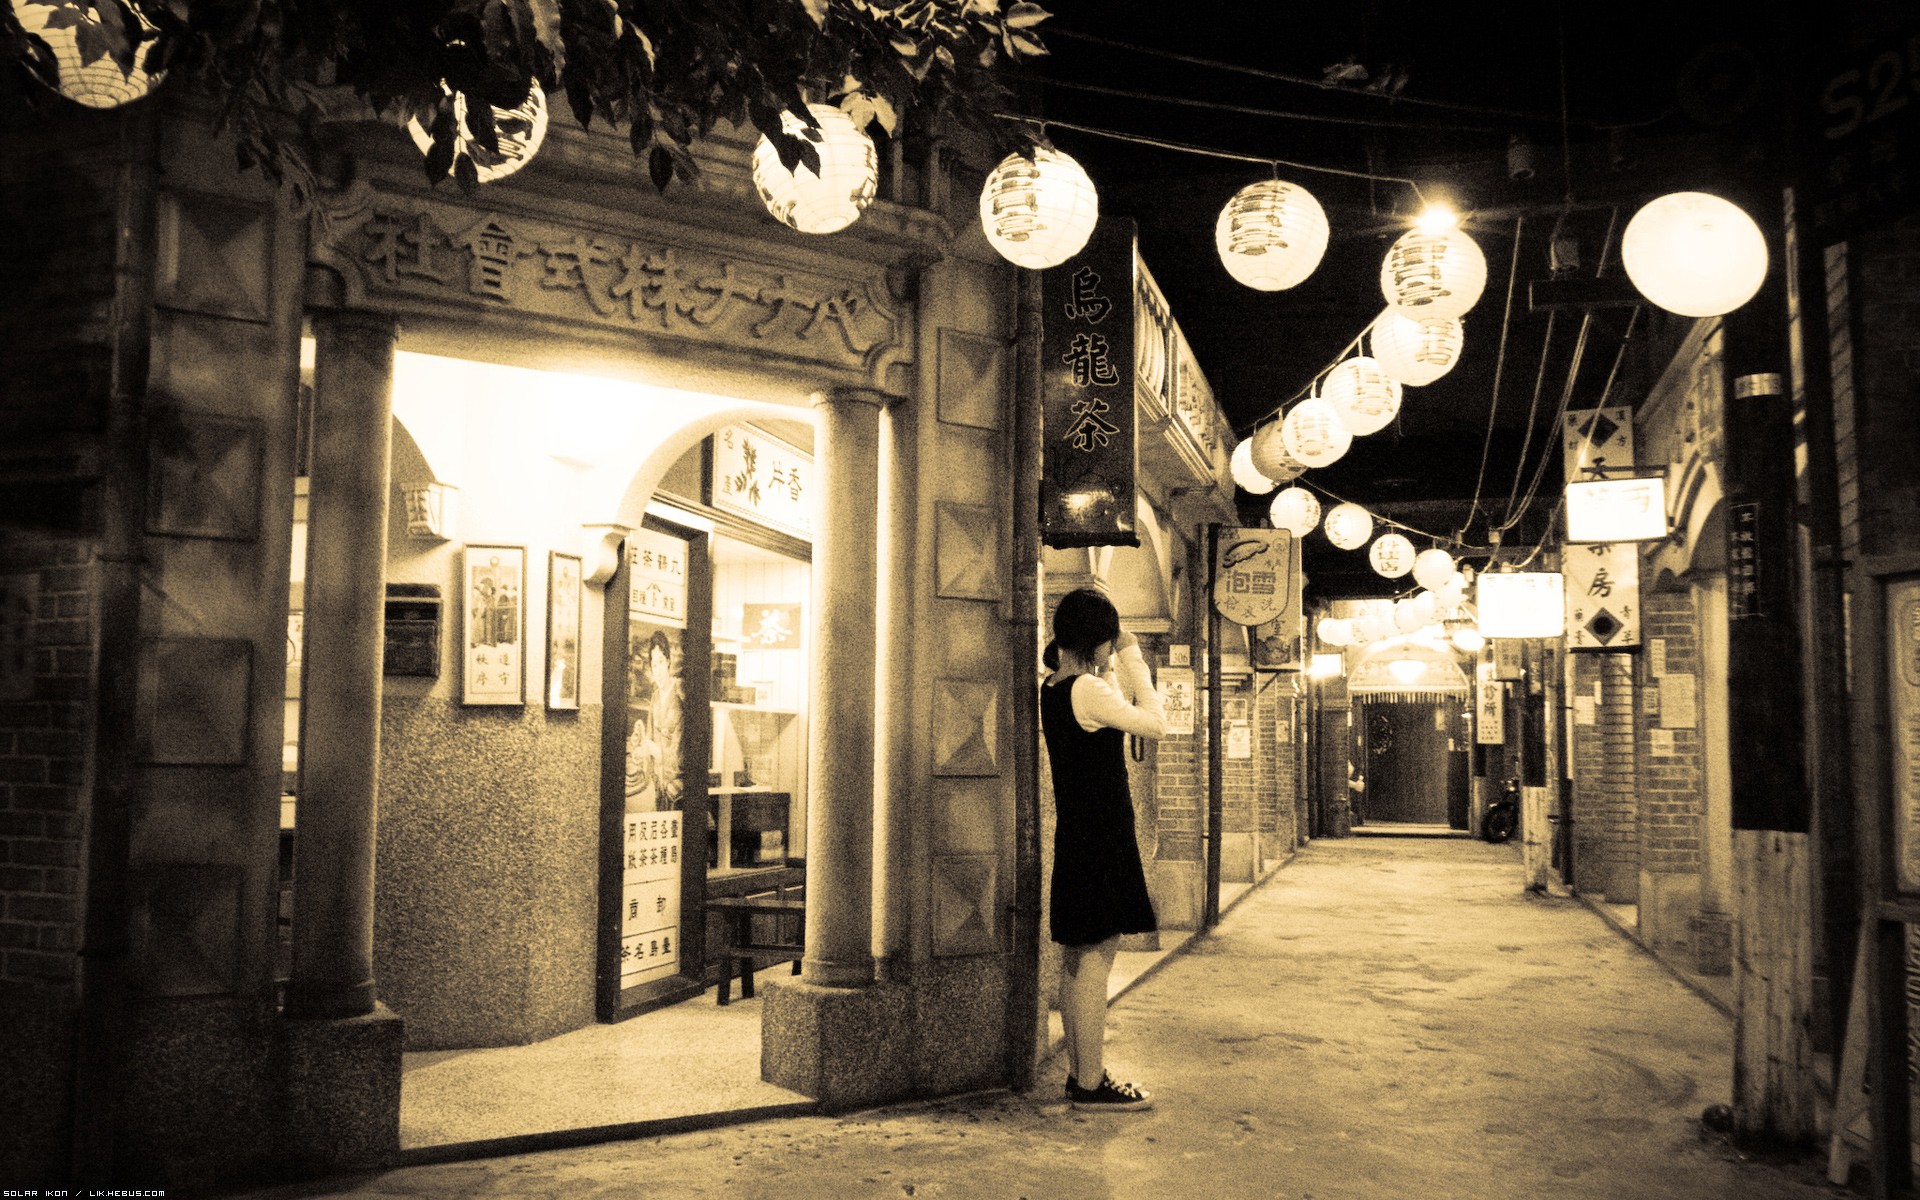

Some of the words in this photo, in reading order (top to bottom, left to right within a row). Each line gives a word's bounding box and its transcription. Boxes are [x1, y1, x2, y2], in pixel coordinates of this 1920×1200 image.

[1063, 266, 1119, 452] 烏龍茶
[751, 609, 793, 644] 茶
